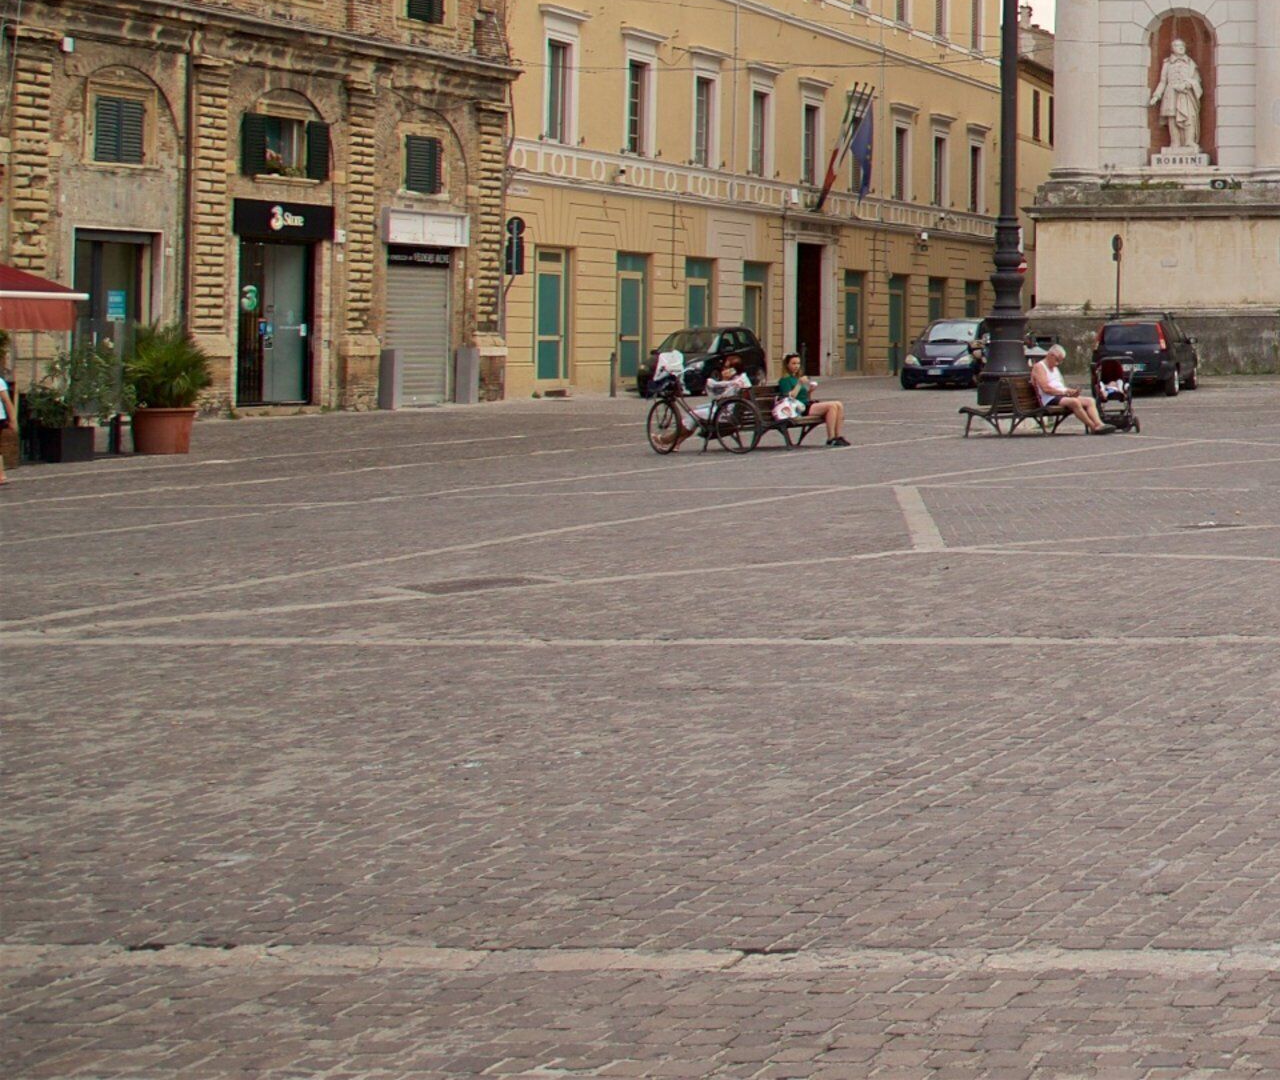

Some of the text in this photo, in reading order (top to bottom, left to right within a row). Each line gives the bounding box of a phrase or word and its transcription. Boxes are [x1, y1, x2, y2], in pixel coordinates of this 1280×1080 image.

[1156, 157, 1202, 165] ROSSINI
[271, 205, 284, 230] 3
[241, 284, 257, 311] 3
